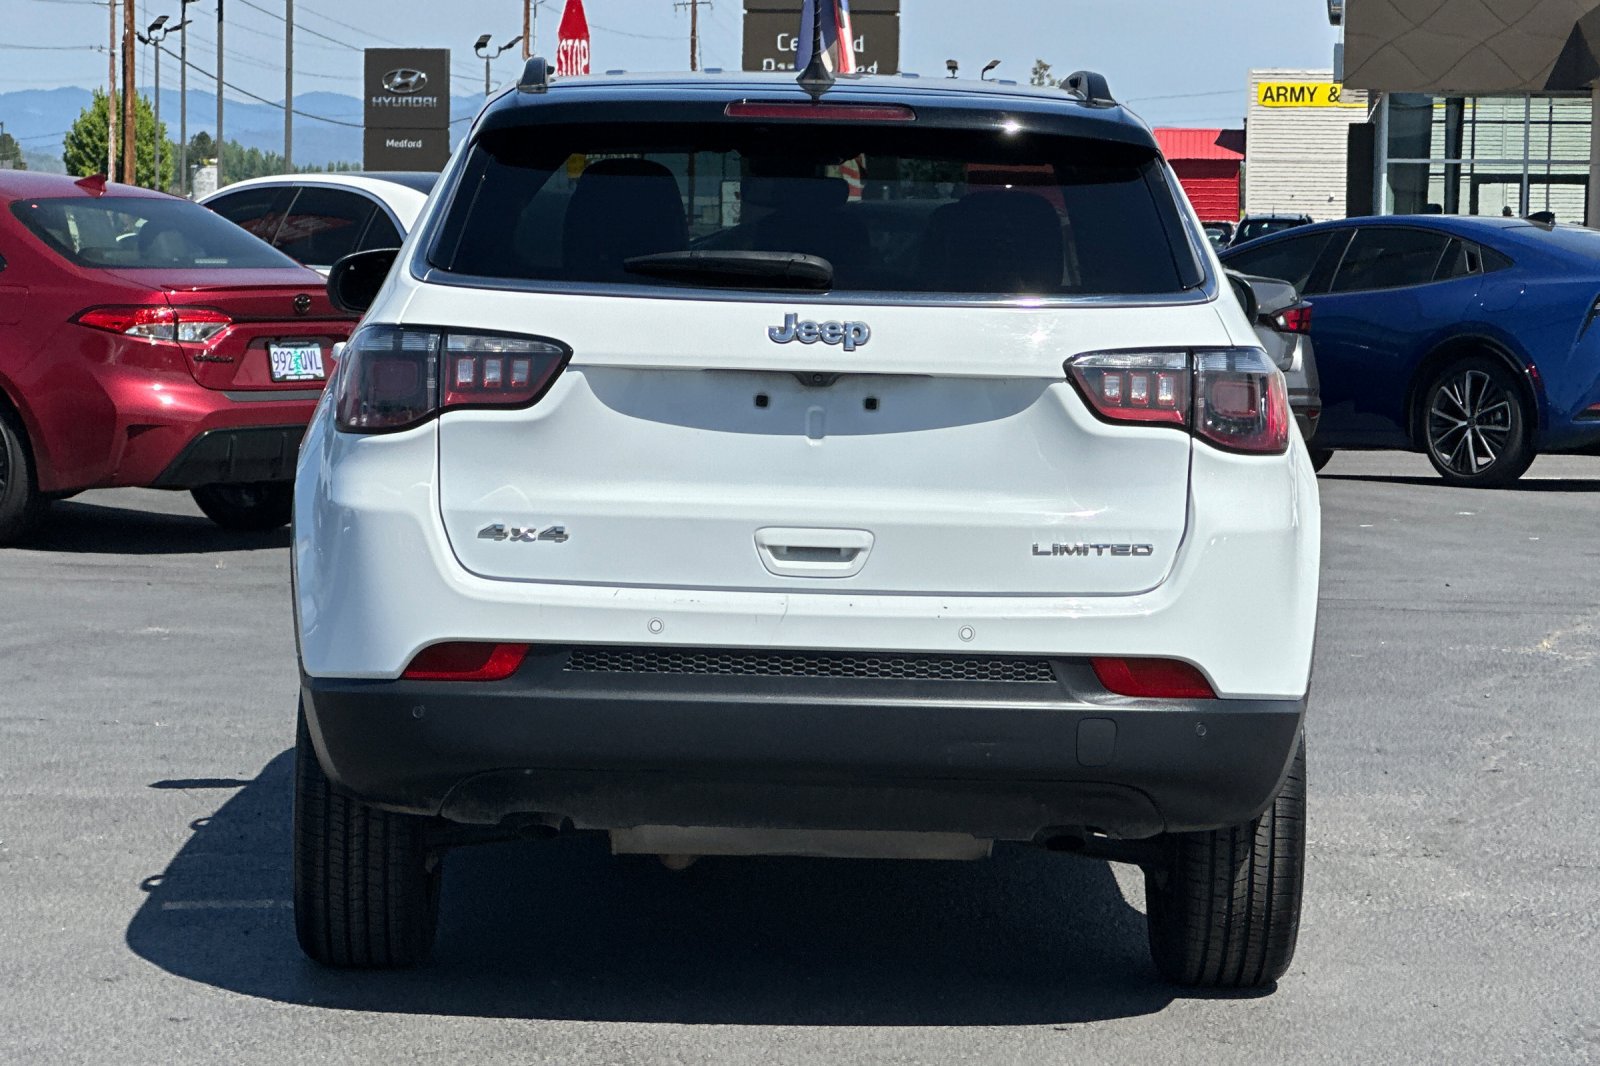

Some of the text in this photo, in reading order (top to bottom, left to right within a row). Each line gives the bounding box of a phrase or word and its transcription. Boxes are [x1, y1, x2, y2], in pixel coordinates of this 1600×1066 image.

[559, 38, 589, 76] STOP
[372, 96, 437, 107] HYUNDAI
[1262, 86, 1340, 102] ARMY &
[386, 139, 422, 148] Medford
[767, 312, 871, 352] Jeep
[477, 523, 569, 543] 4x4
[1031, 543, 1154, 556] LIMITED
